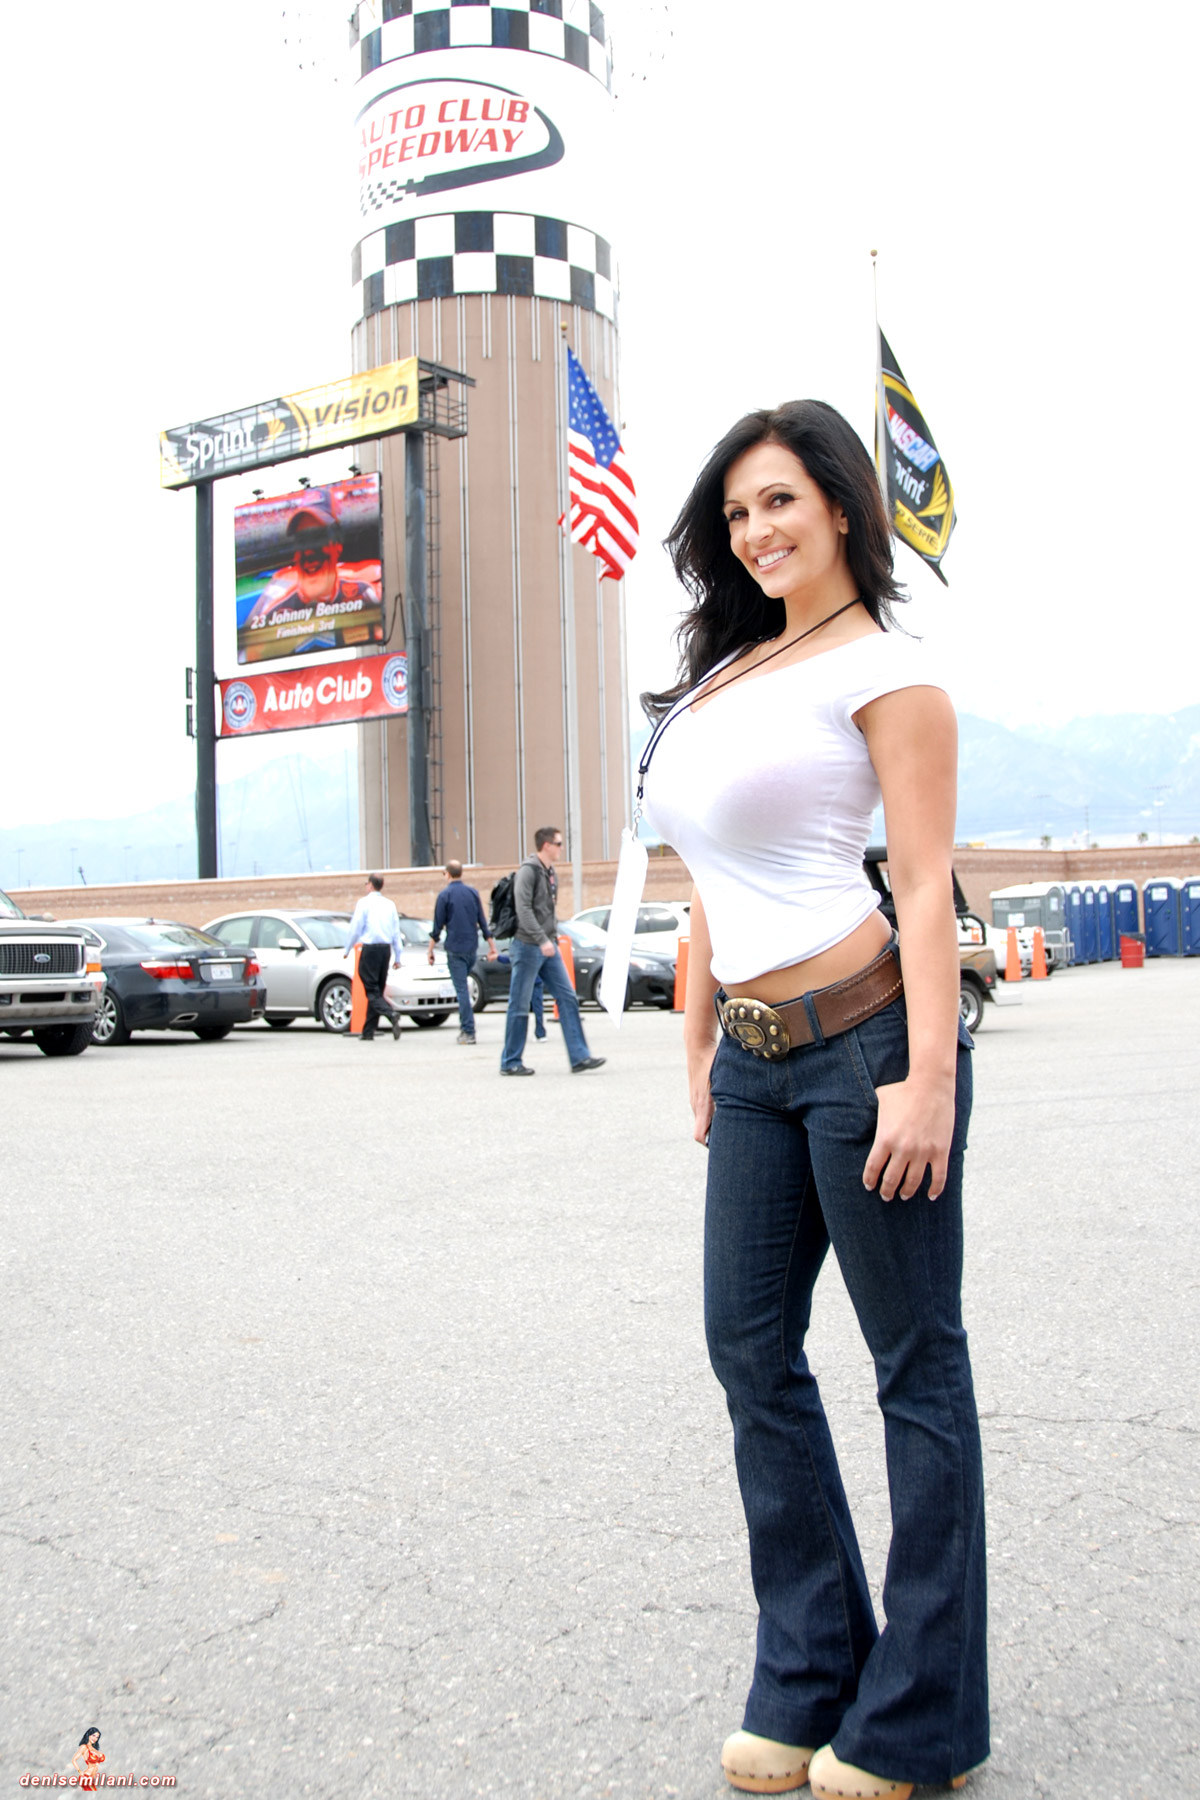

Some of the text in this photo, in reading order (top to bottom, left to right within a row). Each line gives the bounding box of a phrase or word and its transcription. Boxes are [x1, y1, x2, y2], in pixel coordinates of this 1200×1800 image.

[360, 98, 530, 148] AUTO CLUB
[359, 128, 524, 181] SPEEDWAY
[186, 384, 408, 470] Sprint vision
[890, 412, 939, 471] NASCAR
[894, 452, 925, 505] rint
[904, 516, 938, 551] SERIE
[251, 599, 363, 630] 23 Johnny Benson
[276, 619, 336, 639] Finished 3rd
